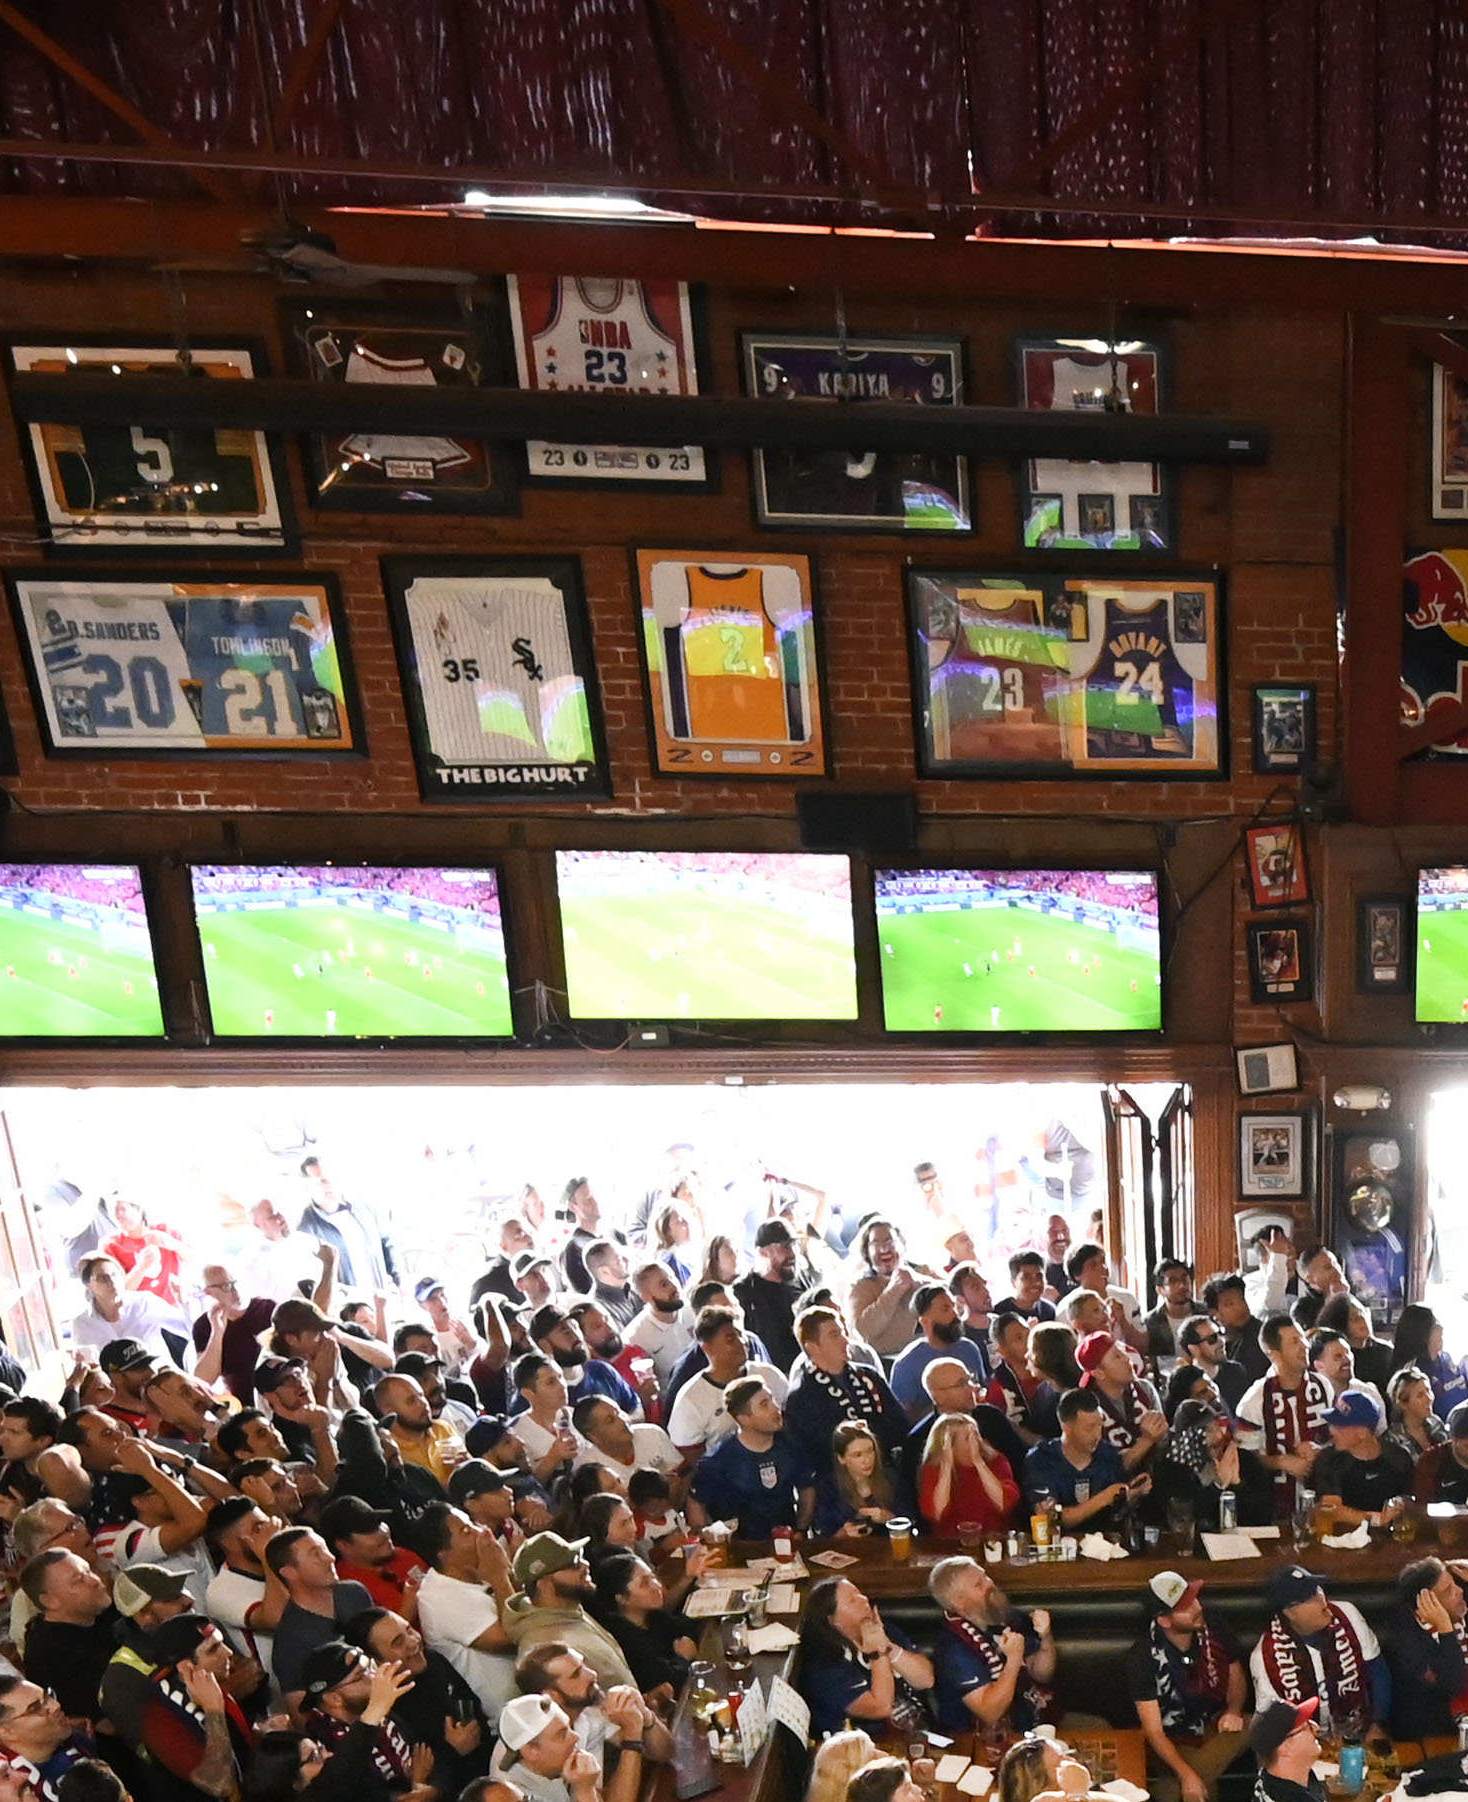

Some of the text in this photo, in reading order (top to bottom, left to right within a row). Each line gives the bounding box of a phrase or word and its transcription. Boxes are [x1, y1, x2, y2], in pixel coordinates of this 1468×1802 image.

[589, 319, 632, 350] NBA
[584, 350, 628, 384] 23
[128, 425, 175, 484] 5
[543, 448, 566, 468] 23
[668, 453, 691, 471] 23
[211, 636, 293, 658] TOMLINSON
[719, 626, 747, 672] 2
[1108, 630, 1168, 661] BRYANT
[443, 659, 480, 682] 35
[1113, 660, 1165, 706] 24
[82, 654, 176, 729] 20
[222, 669, 298, 736] 21
[981, 667, 1025, 712] 23
[667, 748, 692, 765] 2
[790, 750, 815, 767] 2
[1270, 1612, 1302, 1706] utlaws
